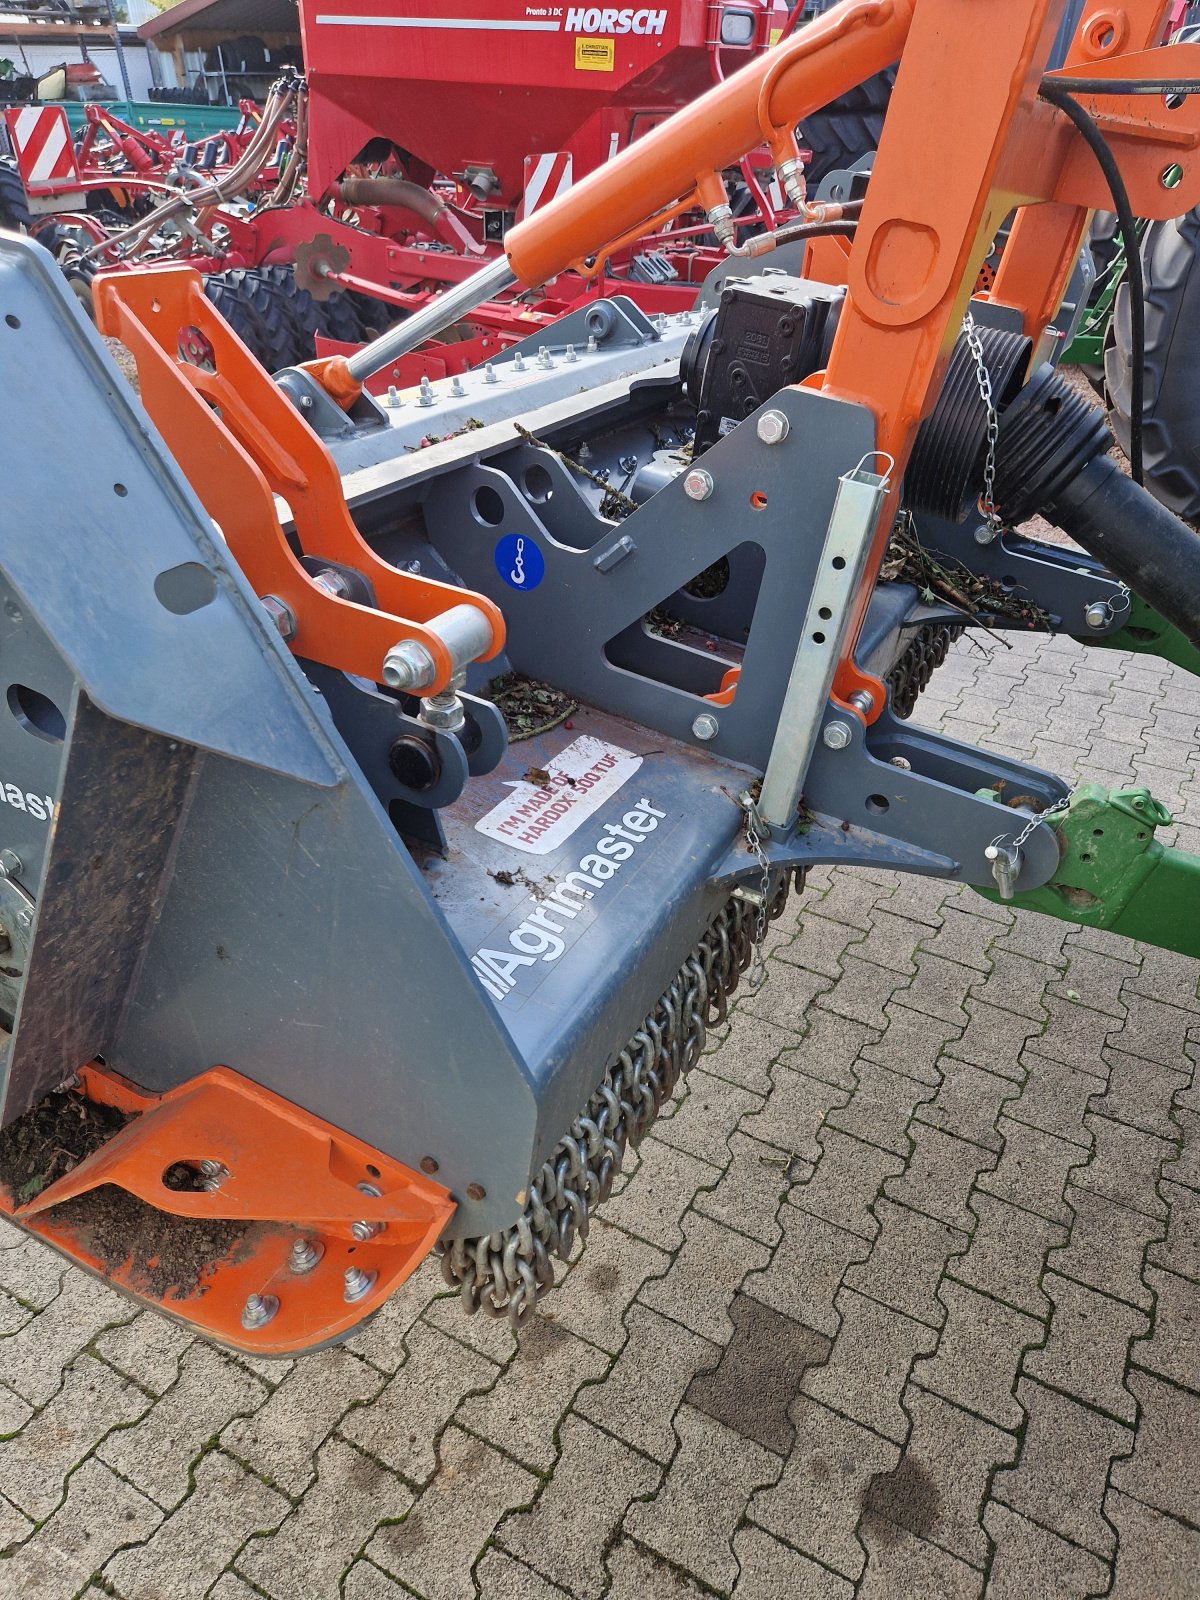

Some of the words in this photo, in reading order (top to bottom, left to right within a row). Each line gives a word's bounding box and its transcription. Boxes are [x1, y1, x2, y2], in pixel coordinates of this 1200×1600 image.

[525, 7, 547, 16] Pronto
[553, 8, 563, 17] DC
[564, 7, 668, 35] HORSCH
[571, 772, 601, 795] 500
[592, 753, 621, 774] TUF
[496, 815, 526, 836] I'M
[516, 784, 559, 818] MADE
[550, 770, 571, 788] OF
[476, 796, 668, 988] Agrimaster
